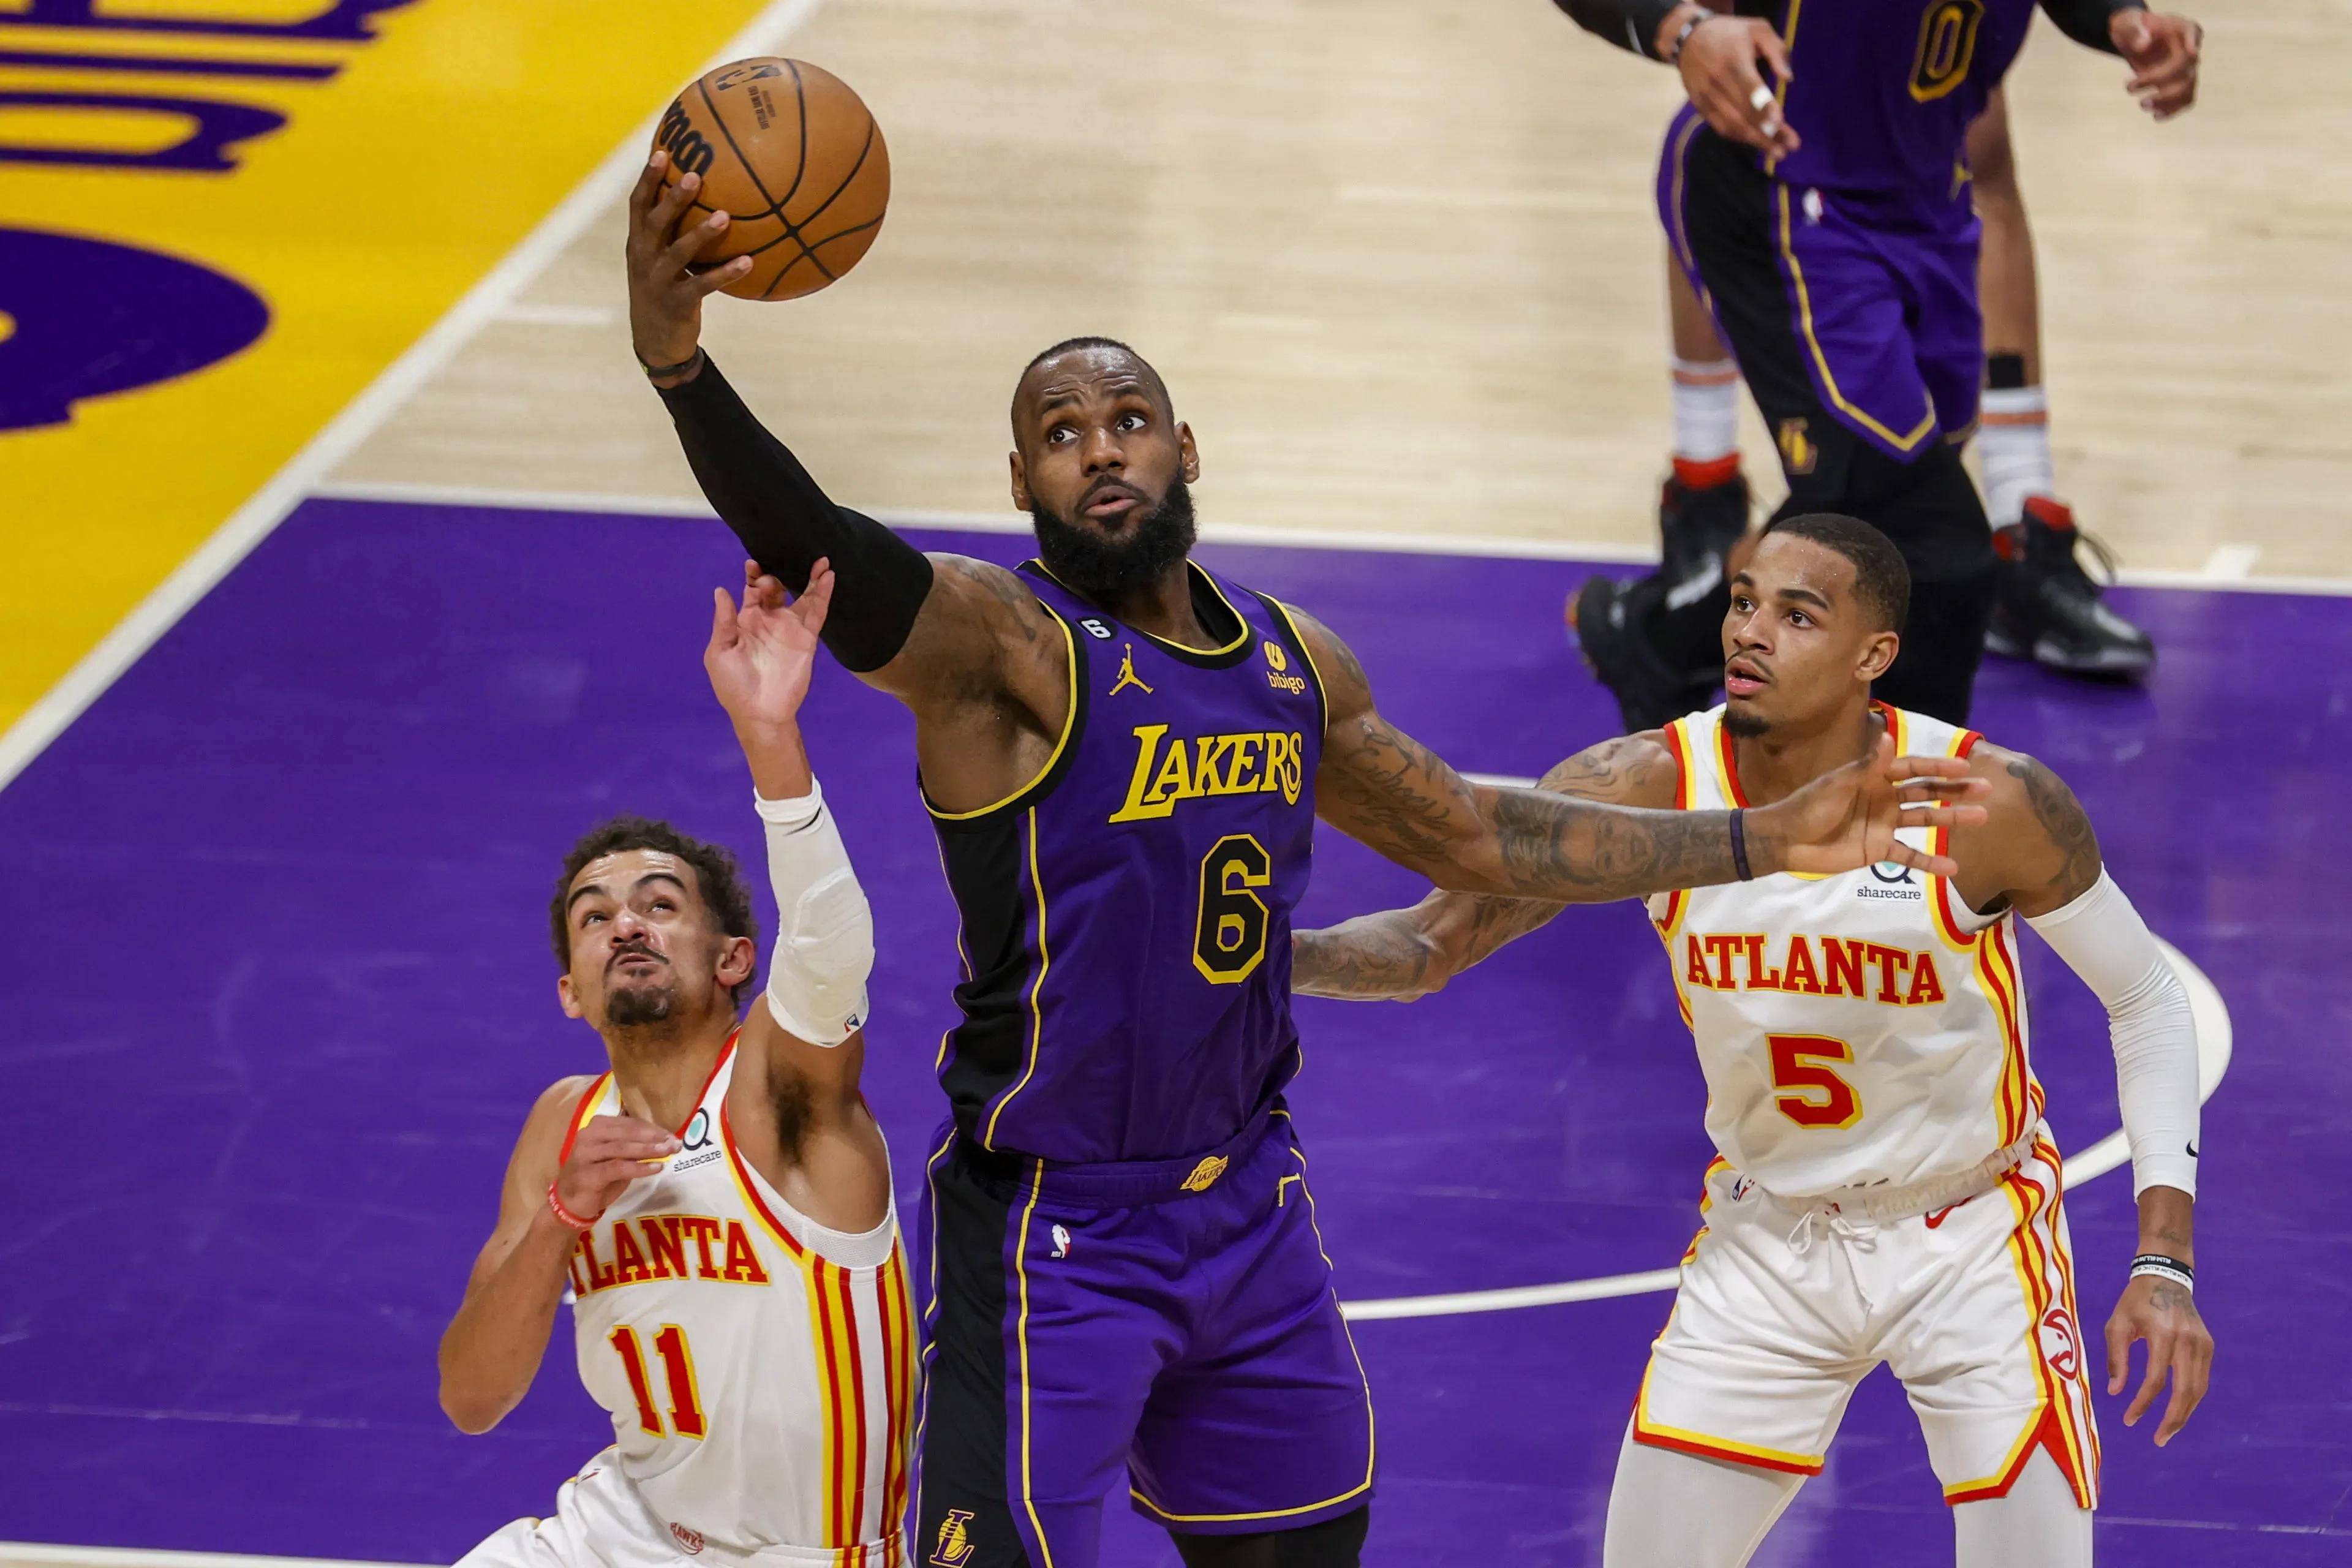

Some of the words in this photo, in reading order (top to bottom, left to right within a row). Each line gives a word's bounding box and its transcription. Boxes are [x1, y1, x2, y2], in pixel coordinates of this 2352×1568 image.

[1909, 0, 1985, 103] 0
[1081, 619, 1111, 638] 6
[1266, 671, 1306, 695] bibigo
[1108, 723, 1303, 823] LAKERS
[1193, 834, 1271, 985] 6
[1856, 886, 1921, 900] sharecare
[1686, 932, 1947, 1008] ATLANTA
[1765, 1033, 1863, 1129] 5
[673, 1149, 722, 1172] sharecare
[607, 1323, 707, 1441] 11
